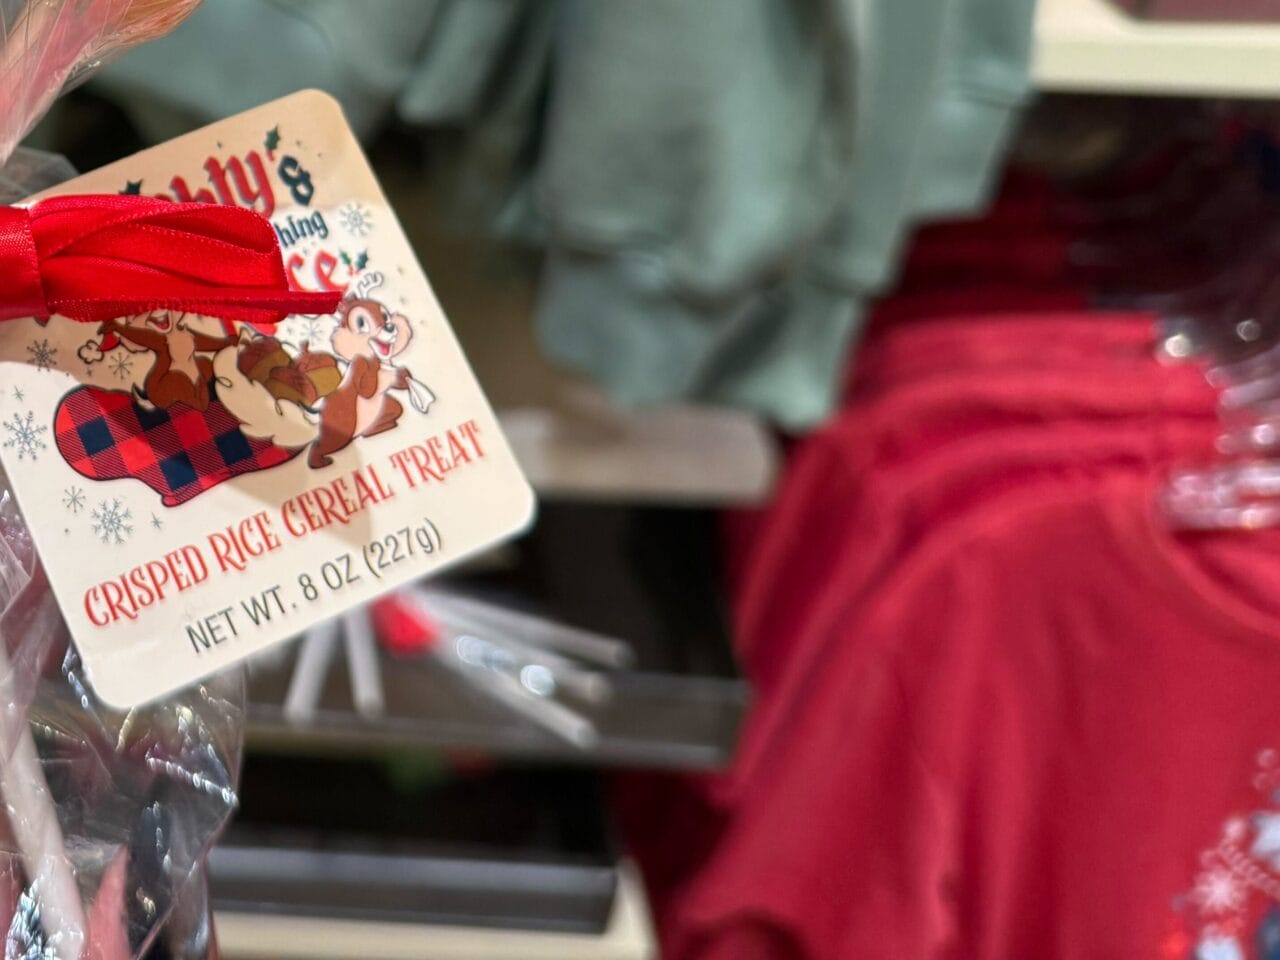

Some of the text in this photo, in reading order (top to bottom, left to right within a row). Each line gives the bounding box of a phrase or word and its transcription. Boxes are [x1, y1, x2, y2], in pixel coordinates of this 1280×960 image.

[83, 419, 487, 628] CRISPED RICE CEREAL TREAT
[185, 517, 443, 654] NET WT. 8 OZ (227g)
